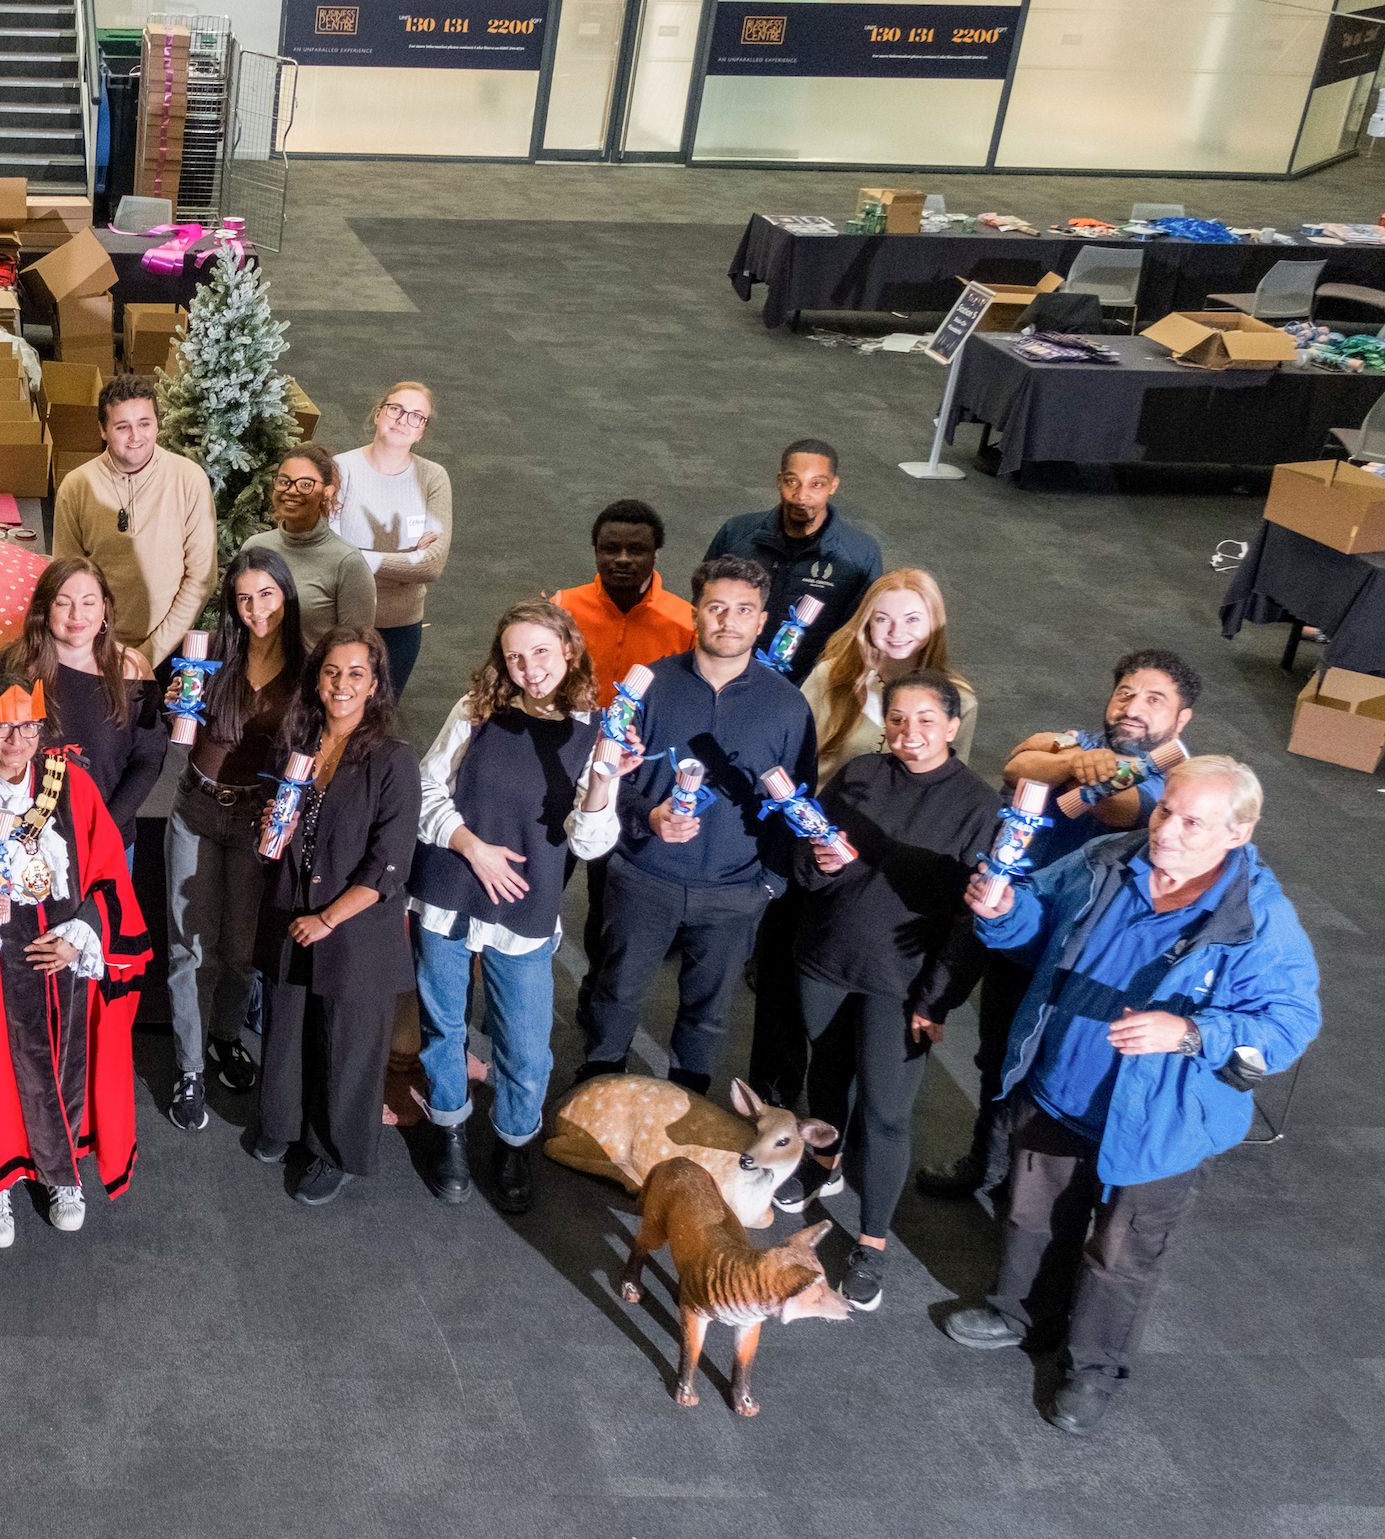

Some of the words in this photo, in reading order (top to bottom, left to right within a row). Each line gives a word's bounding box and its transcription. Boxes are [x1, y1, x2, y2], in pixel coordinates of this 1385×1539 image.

[319, 9, 356, 17] BUSINESS
[319, 14, 355, 24] DESIGN
[318, 22, 355, 31] CENTRE
[405, 17, 435, 32] 130
[443, 18, 469, 33] 131
[487, 19, 535, 35] 2200
[745, 32, 781, 41] CENTRE
[870, 27, 901, 42] 130
[907, 28, 934, 43] 131
[951, 28, 998, 44] 2200
